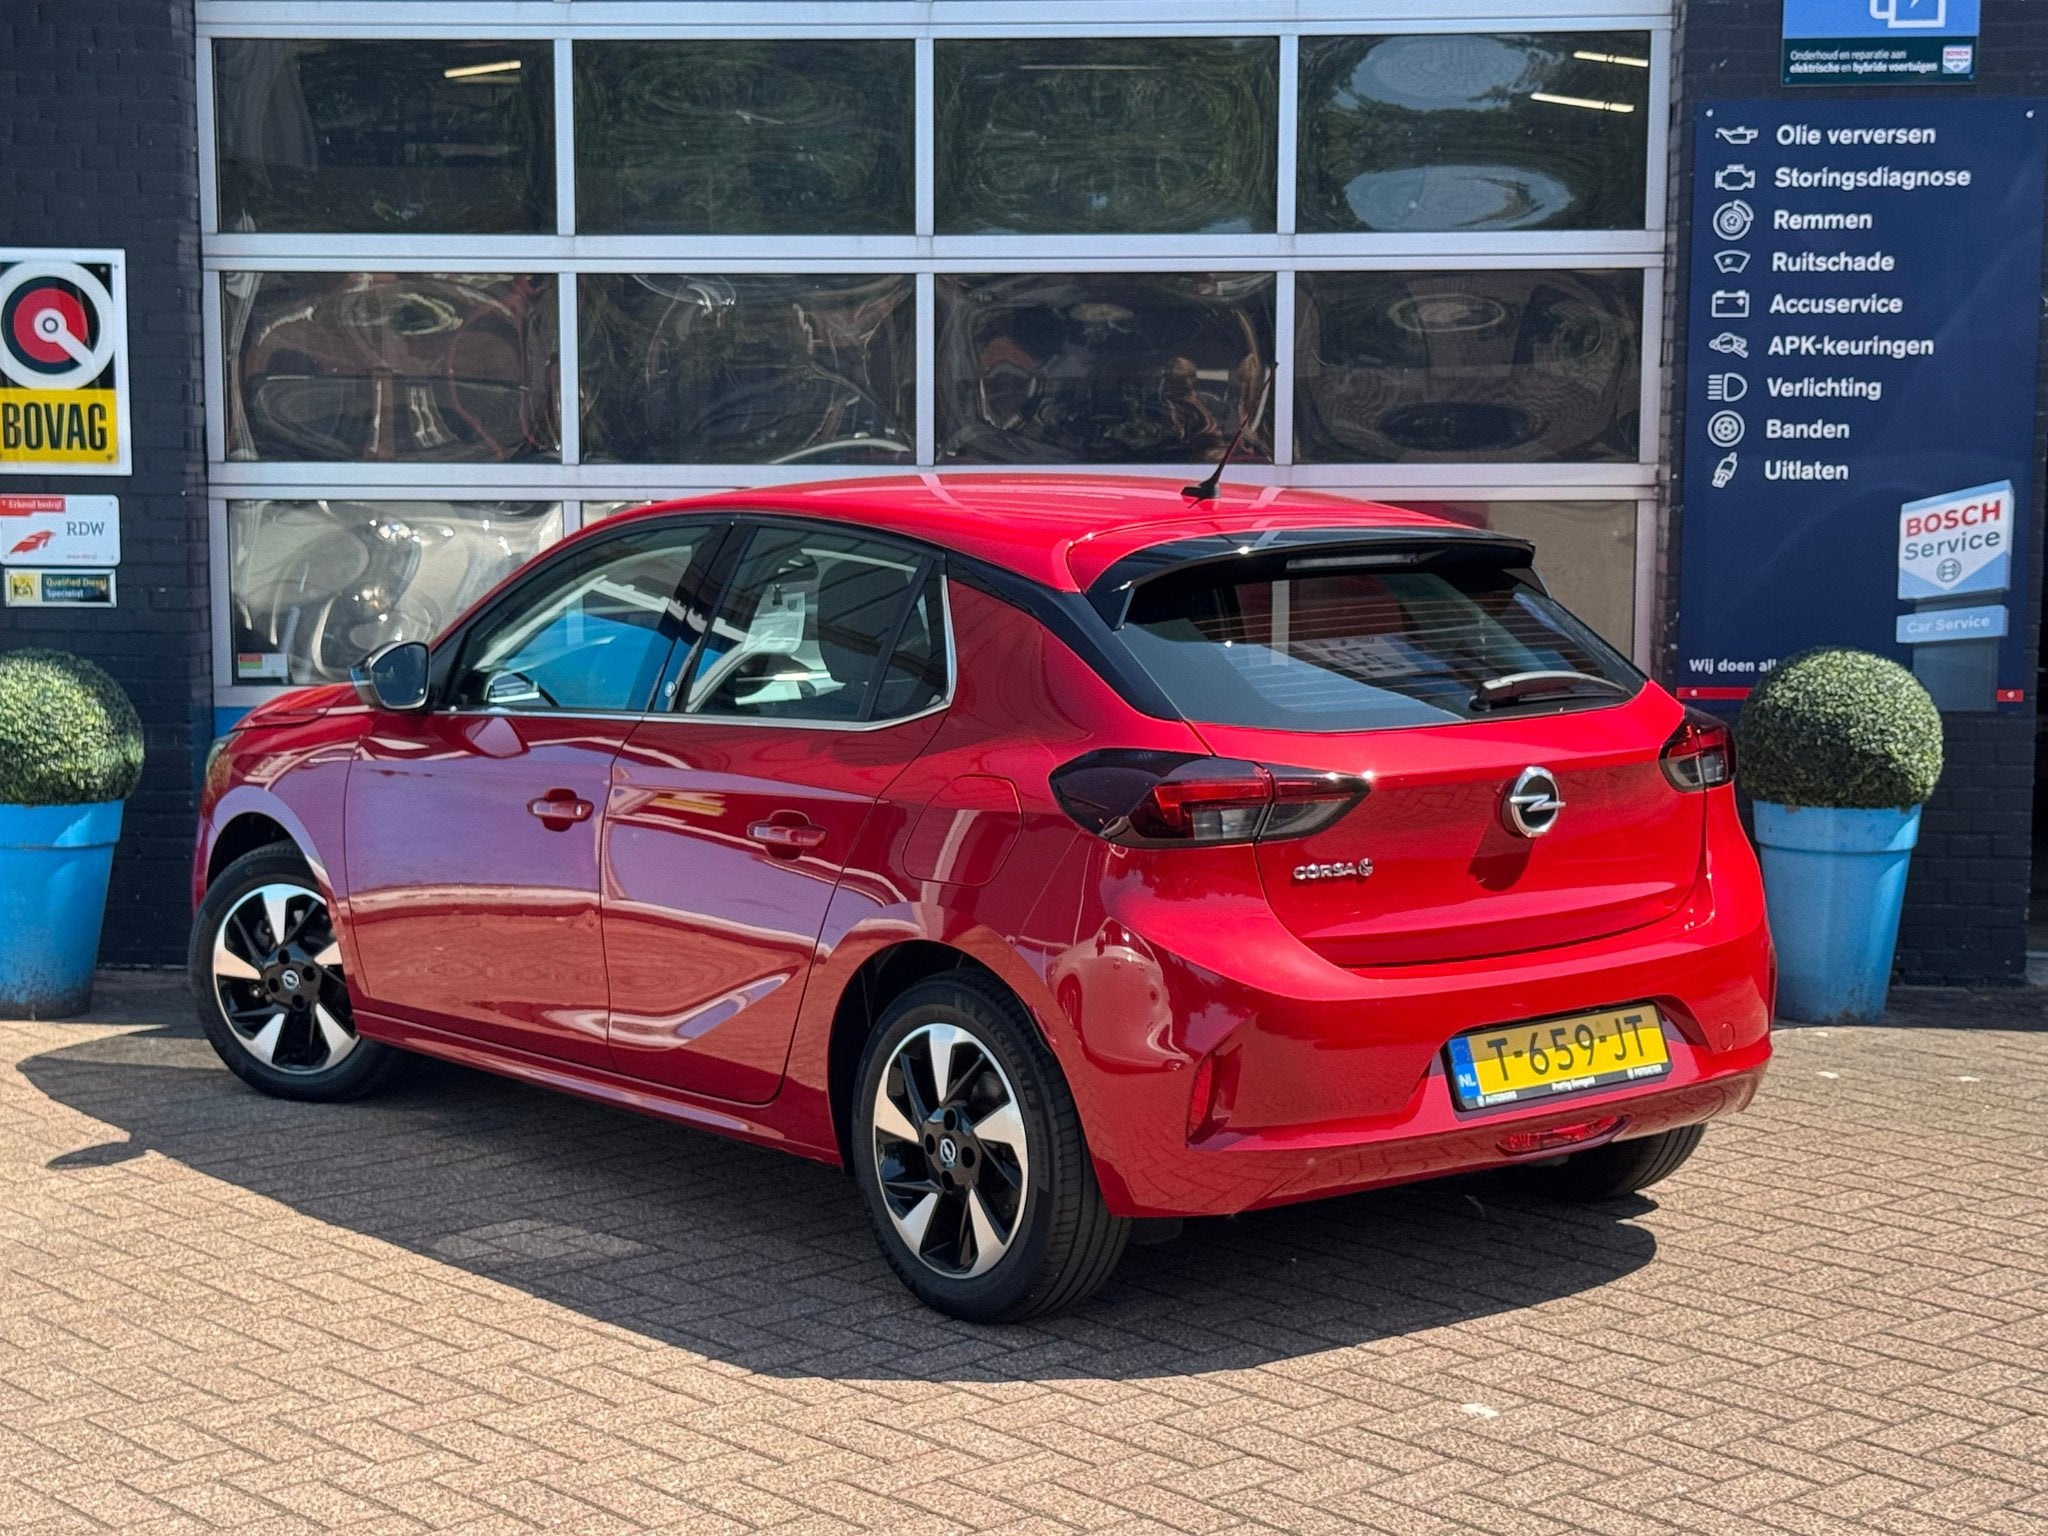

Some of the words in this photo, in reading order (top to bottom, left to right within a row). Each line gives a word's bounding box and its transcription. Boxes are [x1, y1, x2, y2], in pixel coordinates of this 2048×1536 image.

[1789, 62, 1840, 73] elektrische
[1852, 61, 1888, 74] hybride
[1888, 61, 1938, 74] voertuigen
[1776, 124, 1821, 146] Olie
[1827, 127, 1936, 145] verversen
[1774, 167, 1972, 191] Storingsdiagnose
[1773, 209, 1873, 230] Remmen
[1772, 250, 1895, 272] Ruitschade
[1769, 293, 1903, 314] Accuservice
[1767, 335, 1935, 359] APK-keuringen
[1766, 376, 1882, 400] Verlichting
[2, 402, 108, 451] BOVAG
[1766, 418, 1850, 439] Banden
[1764, 459, 1849, 480] Uitlaten
[66, 521, 105, 536] RDW
[1906, 500, 2002, 537] BOSCH
[1904, 531, 2001, 561] Service
[46, 578, 81, 587] Qualified
[46, 588, 84, 598] Specialist
[1906, 619, 1932, 634] Car
[1935, 615, 1991, 632] Service
[1689, 658, 1714, 675] Wij
[1718, 658, 1755, 672] doen
[1293, 862, 1357, 880] CORSA
[1487, 1014, 1643, 1082] T-659-JT
[1459, 1073, 1477, 1087] NL
